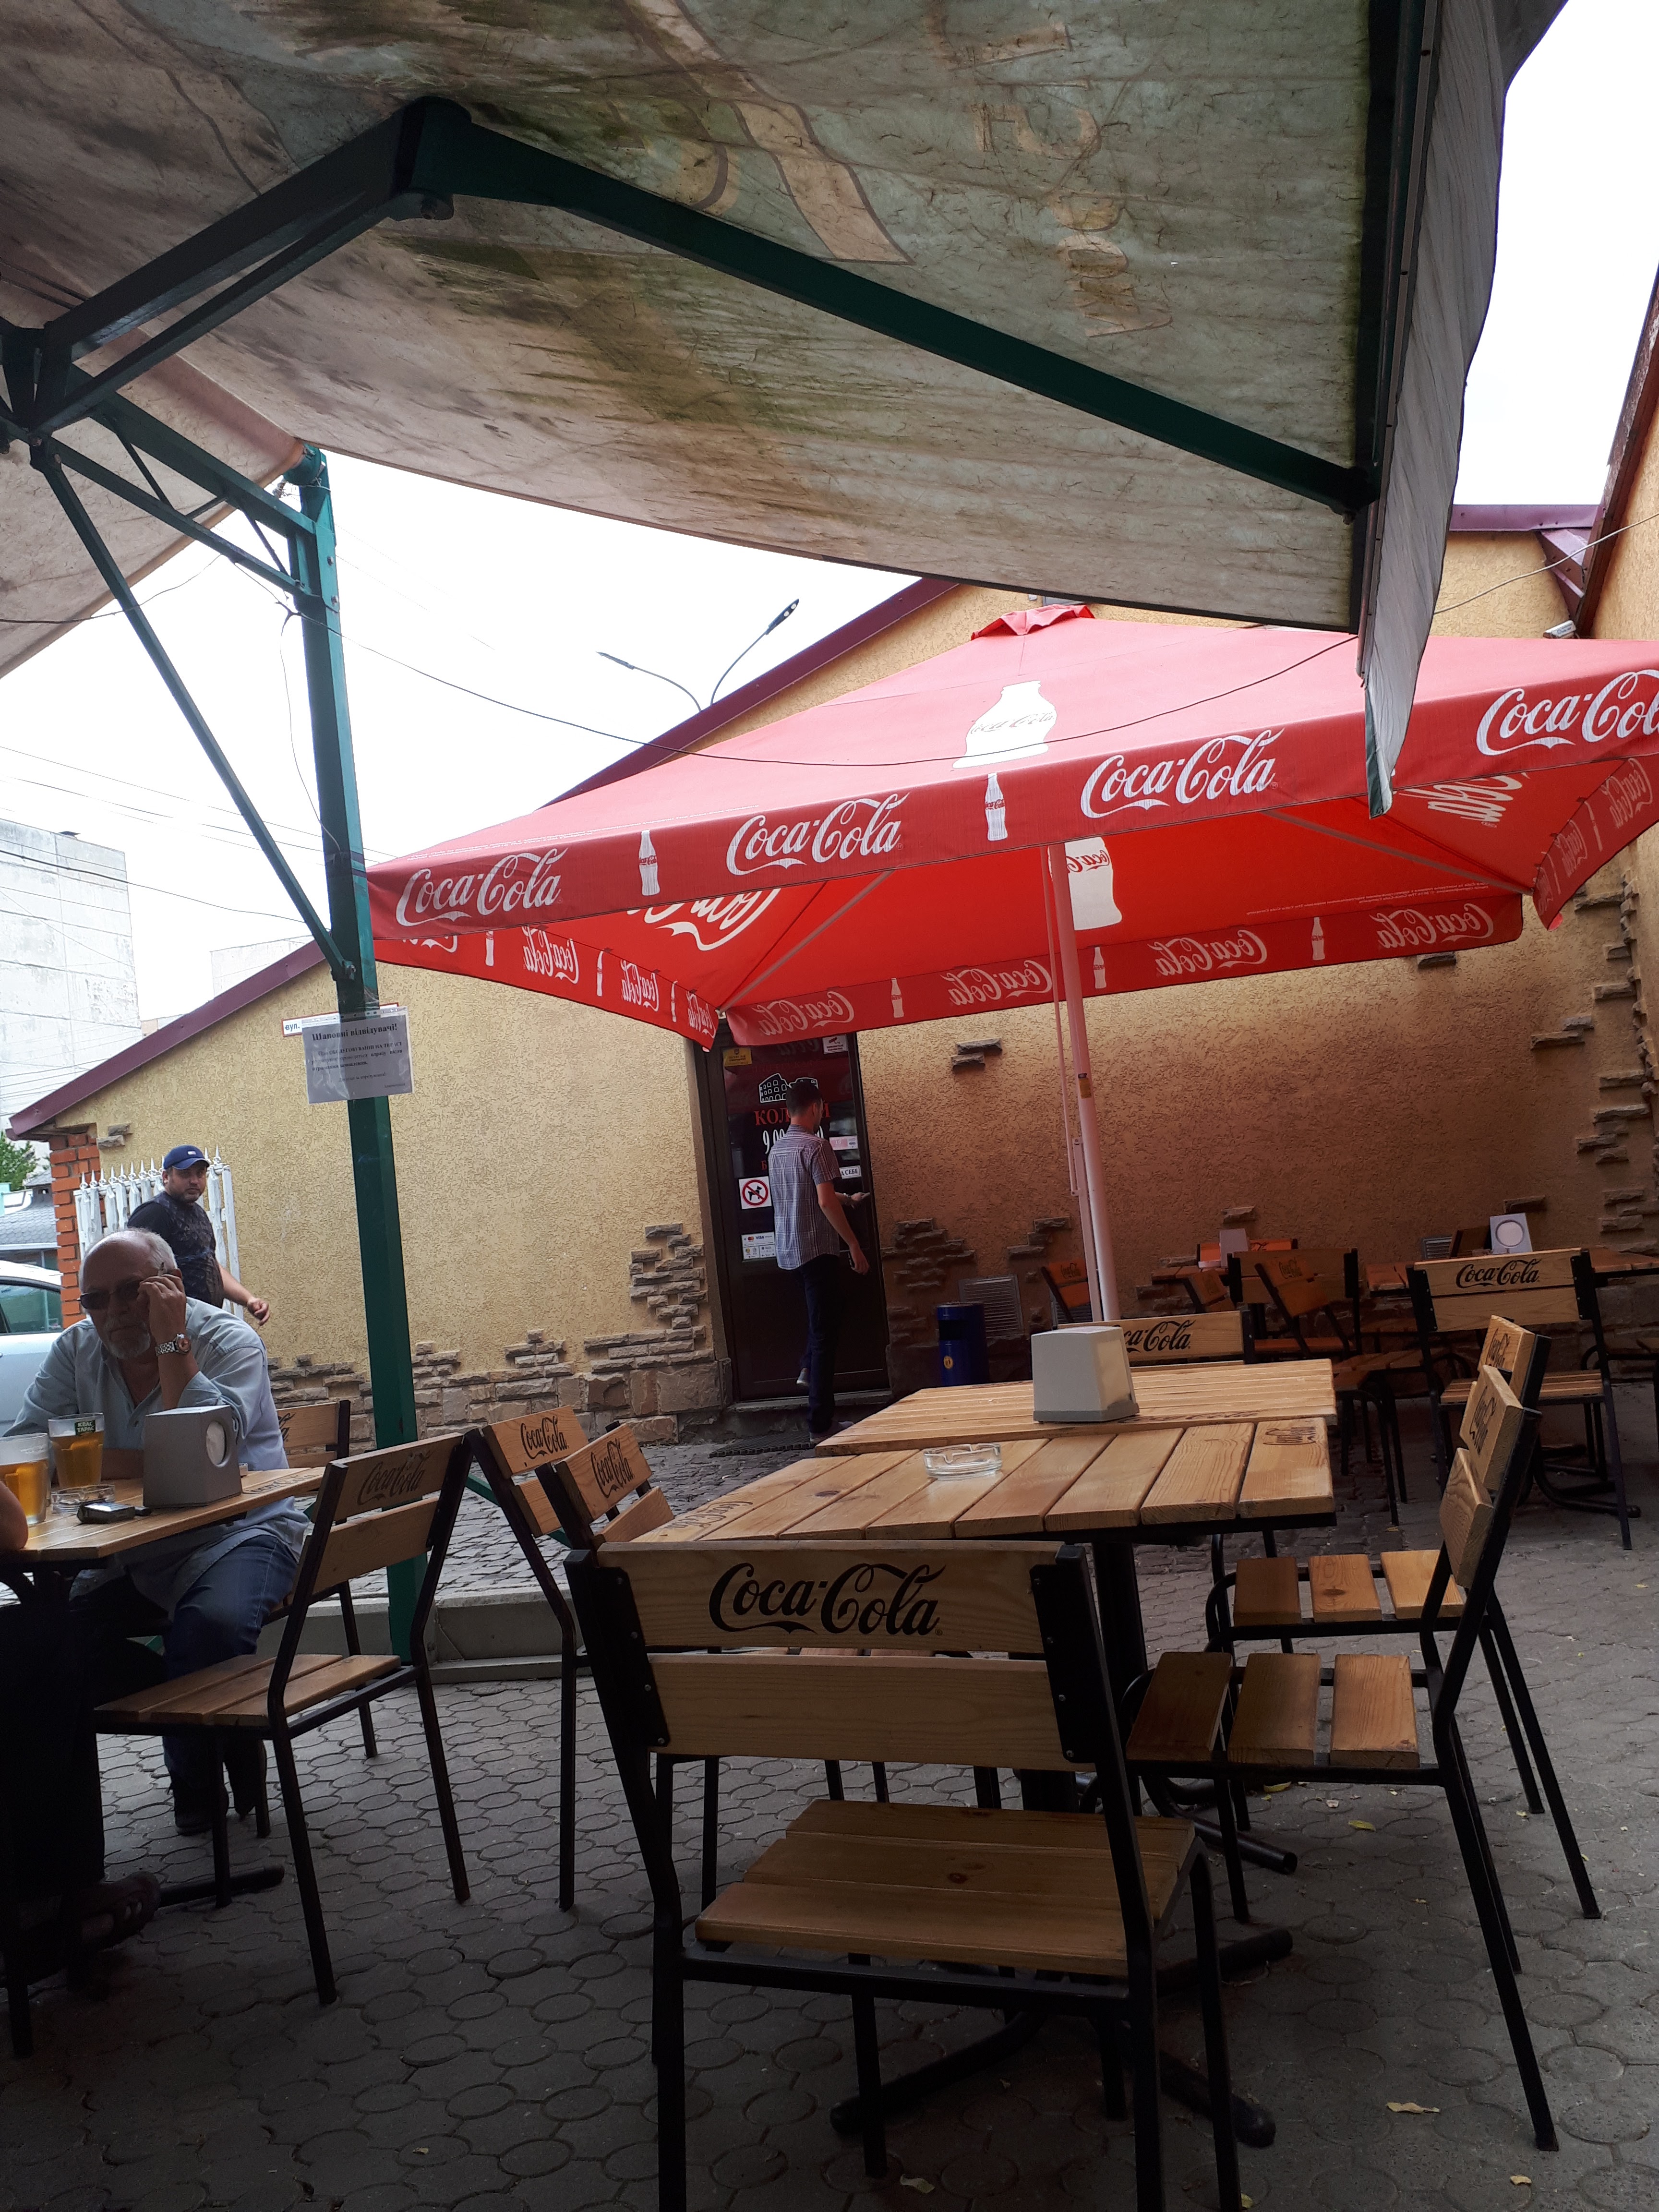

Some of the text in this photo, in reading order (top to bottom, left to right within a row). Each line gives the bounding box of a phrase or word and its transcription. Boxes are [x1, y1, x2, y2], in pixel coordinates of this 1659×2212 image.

[1080, 727, 1286, 818] Coca-Cola
[726, 792, 910, 876] Coca-Cola
[396, 847, 569, 927] Coca-Cola
[285, 1023, 300, 1032] вул.
[350, 1023, 398, 1036] відвідувачі!
[1456, 1259, 1541, 1288] Coca-Cola
[520, 1416, 568, 1460] Coca-Cola
[595, 1437, 635, 1498] Coca-Cola
[709, 1563, 946, 1637] Coca-Cola
